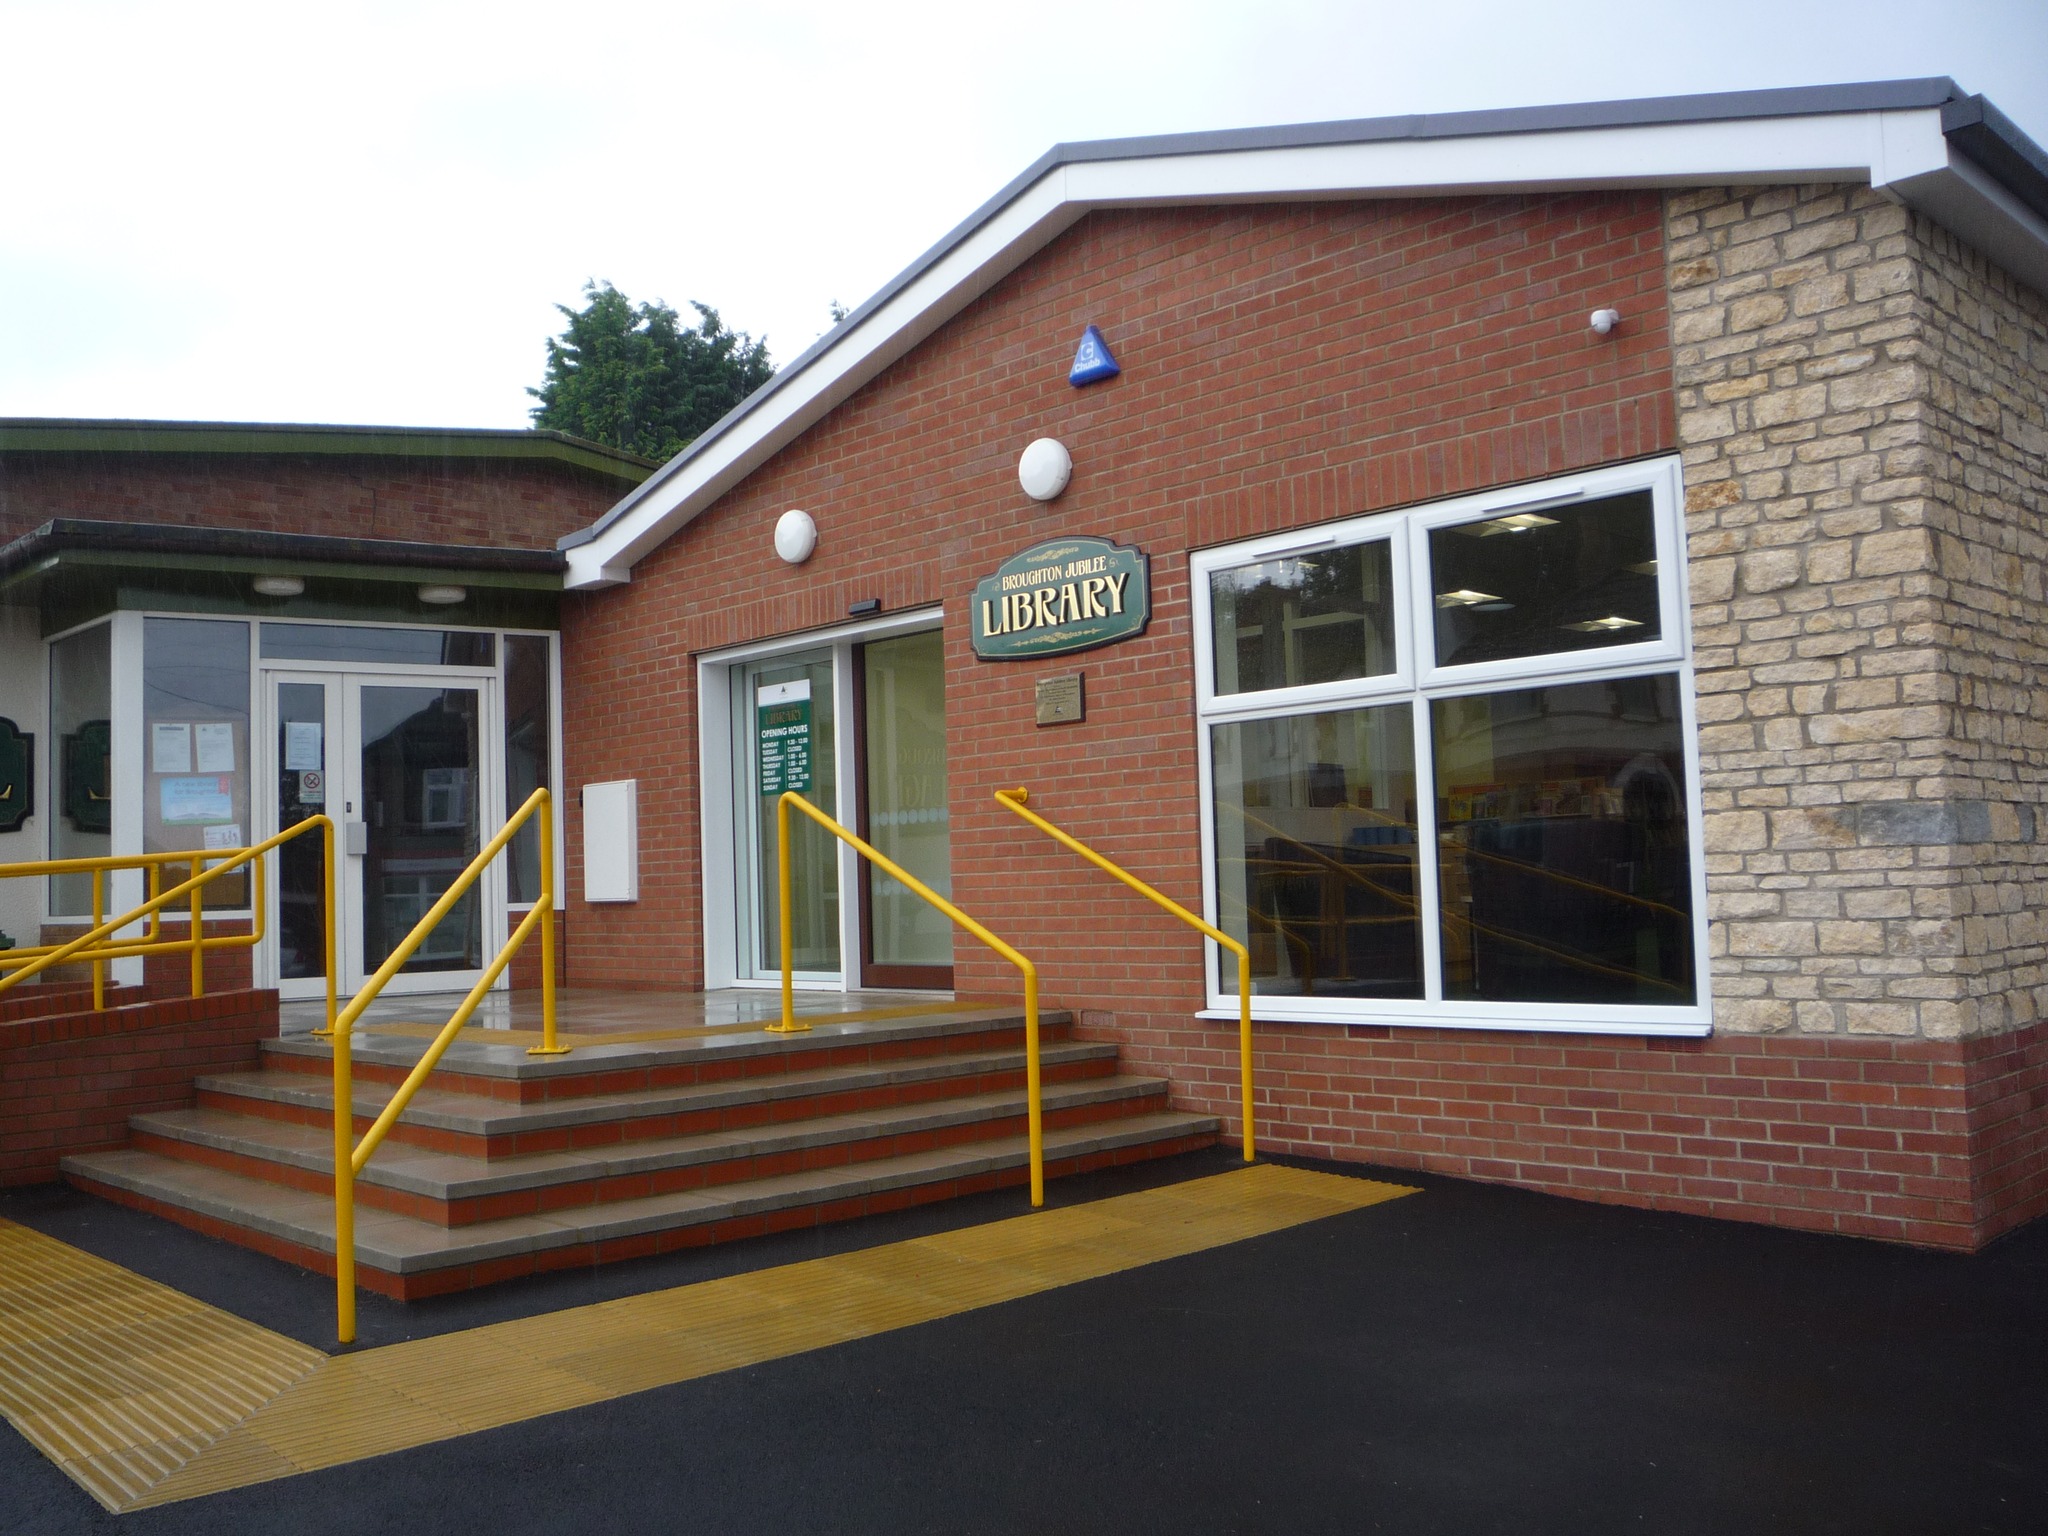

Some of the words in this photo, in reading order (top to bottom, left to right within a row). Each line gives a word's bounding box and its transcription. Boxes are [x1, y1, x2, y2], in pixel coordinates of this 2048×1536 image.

[1002, 565, 1063, 592] BROUGHTON
[1065, 555, 1107, 579] JUBILEE
[982, 572, 1130, 637] LIBRARY
[761, 727, 787, 738] OPENING
[788, 724, 808, 735] HOURS
[787, 745, 802, 753] CLOSED
[787, 766, 803, 774] CLOSED
[788, 781, 803, 789] CLOSED
